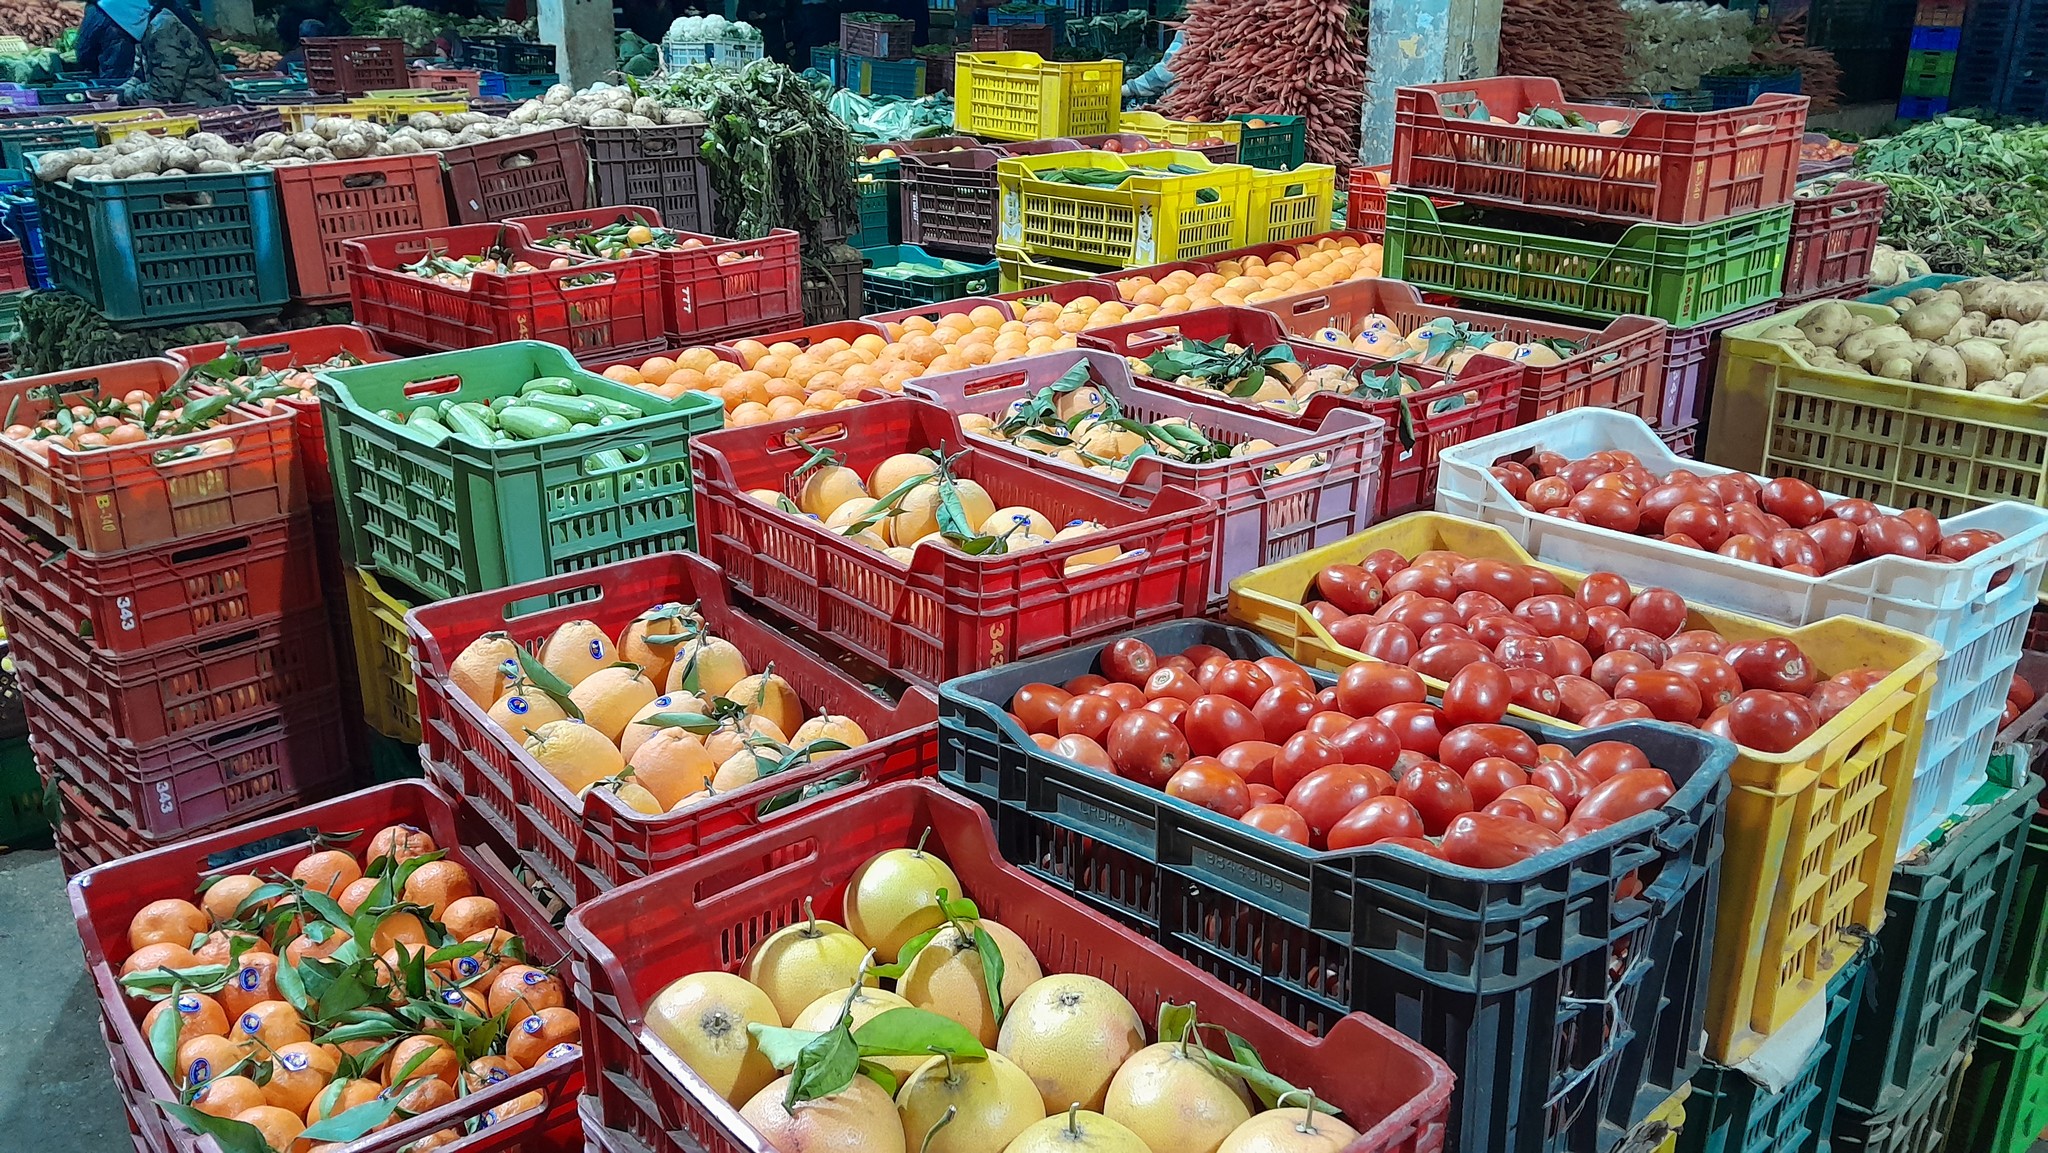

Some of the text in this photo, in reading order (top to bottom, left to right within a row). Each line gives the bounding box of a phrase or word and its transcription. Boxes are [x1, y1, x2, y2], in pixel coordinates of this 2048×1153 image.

[681, 285, 692, 315] 777
[95, 494, 117, 533] B-340
[115, 596, 136, 632] 343
[990, 621, 1005, 669] 343
[155, 780, 174, 815] 343
